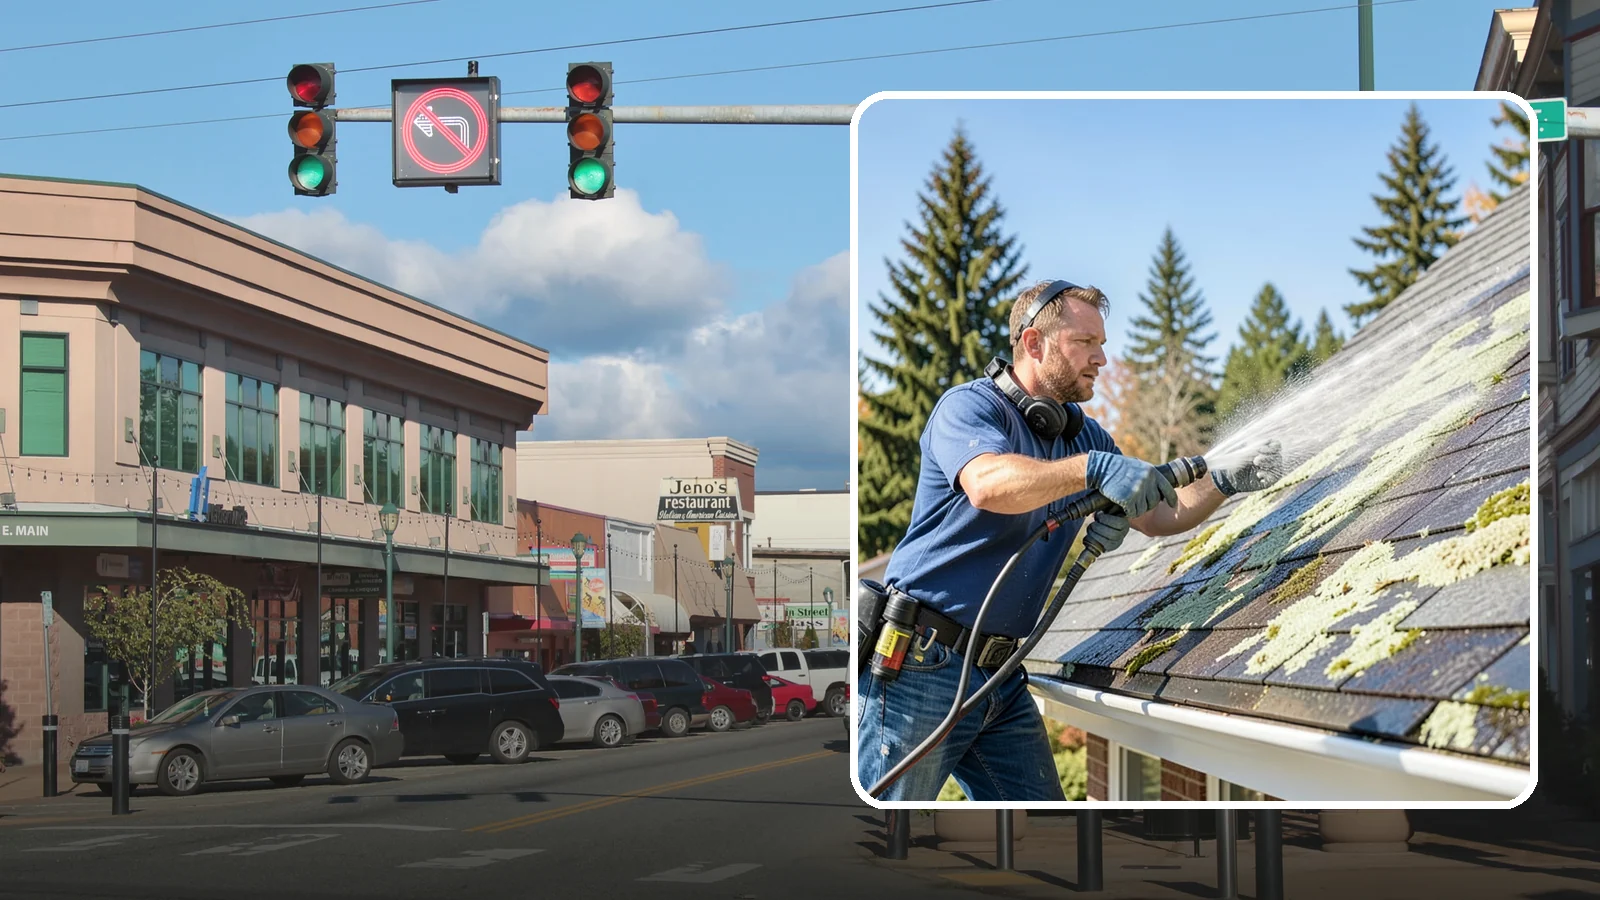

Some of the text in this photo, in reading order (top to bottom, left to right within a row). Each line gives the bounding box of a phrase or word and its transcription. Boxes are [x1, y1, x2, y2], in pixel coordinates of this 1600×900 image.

[669, 480, 727, 494] Jeno's
[665, 496, 731, 509] restaurant
[658, 510, 682, 520] Italian
[685, 509, 714, 520] American
[715, 509, 737, 519] Cuisine
[2, 525, 49, 536] E. MAIN
[797, 608, 829, 617] Street
